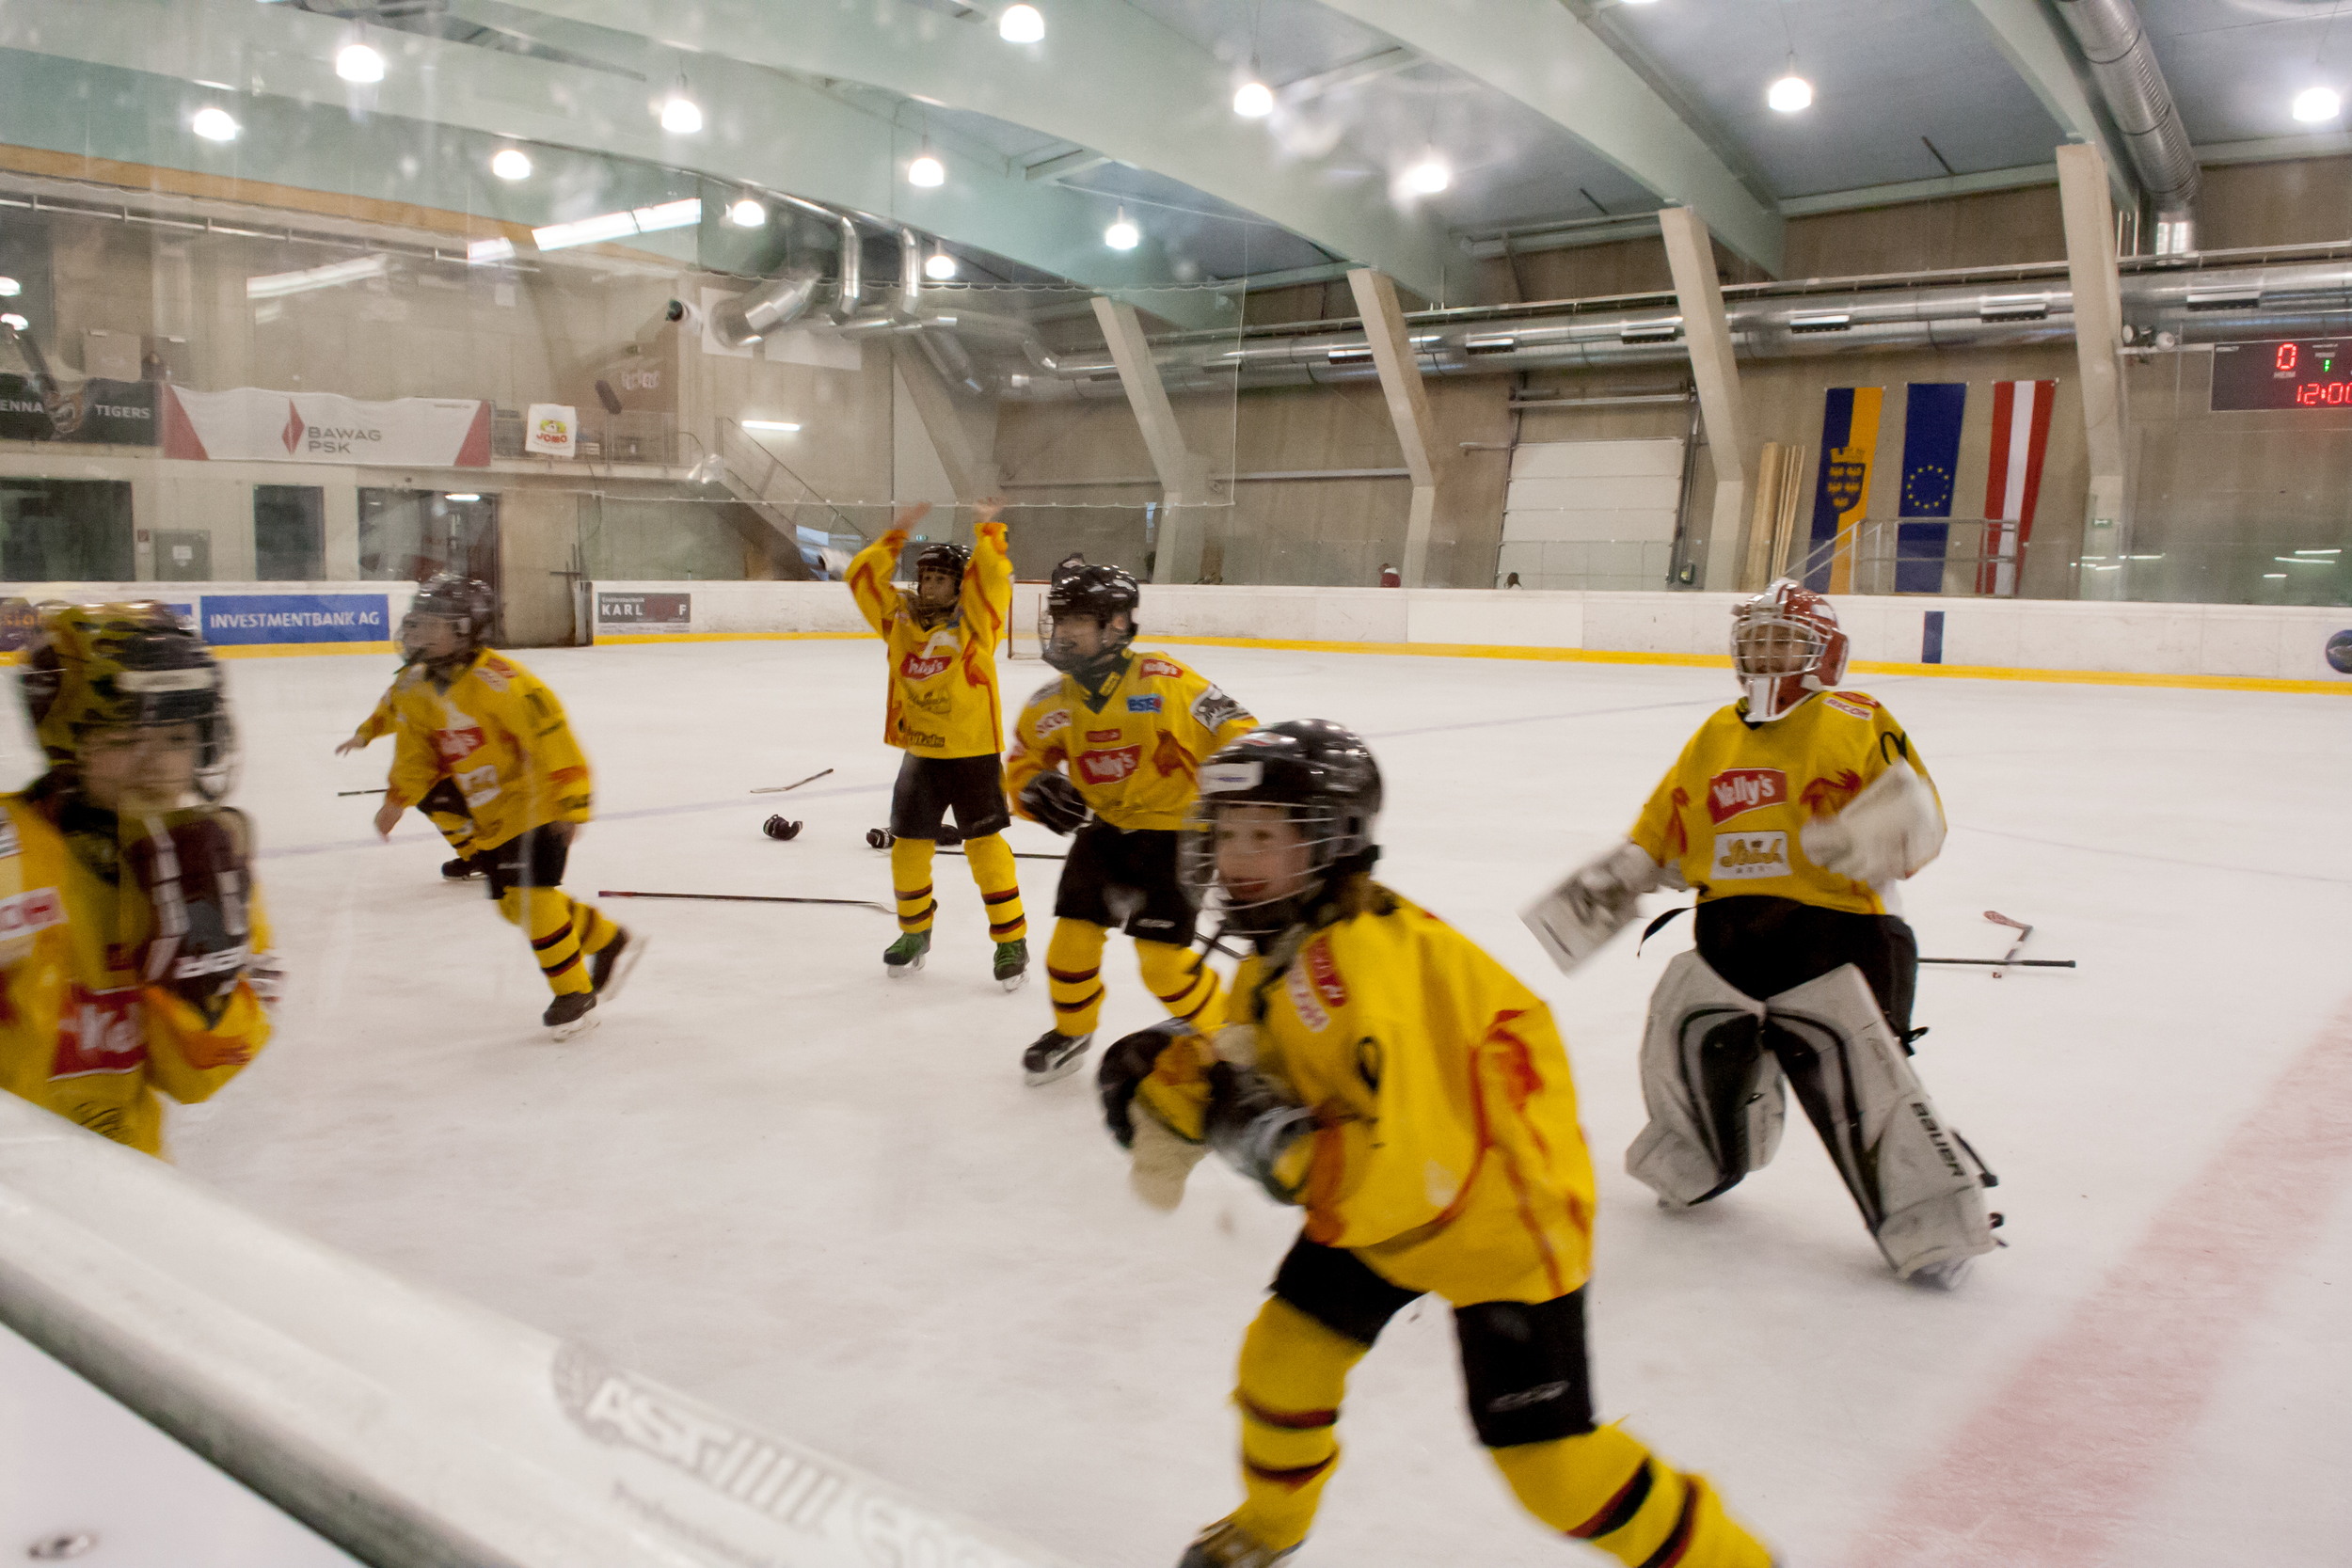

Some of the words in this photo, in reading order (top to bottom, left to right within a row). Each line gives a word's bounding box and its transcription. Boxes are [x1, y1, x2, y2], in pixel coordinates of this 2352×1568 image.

[2277, 343, 2297, 370] 0
[95, 404, 151, 420] TIGERS
[308, 426, 382, 442] BAWAG
[308, 440, 351, 454] PSK
[602, 604, 644, 616] KARL
[210, 612, 355, 628] INVESTMENTBANK
[358, 611, 380, 626] AG
